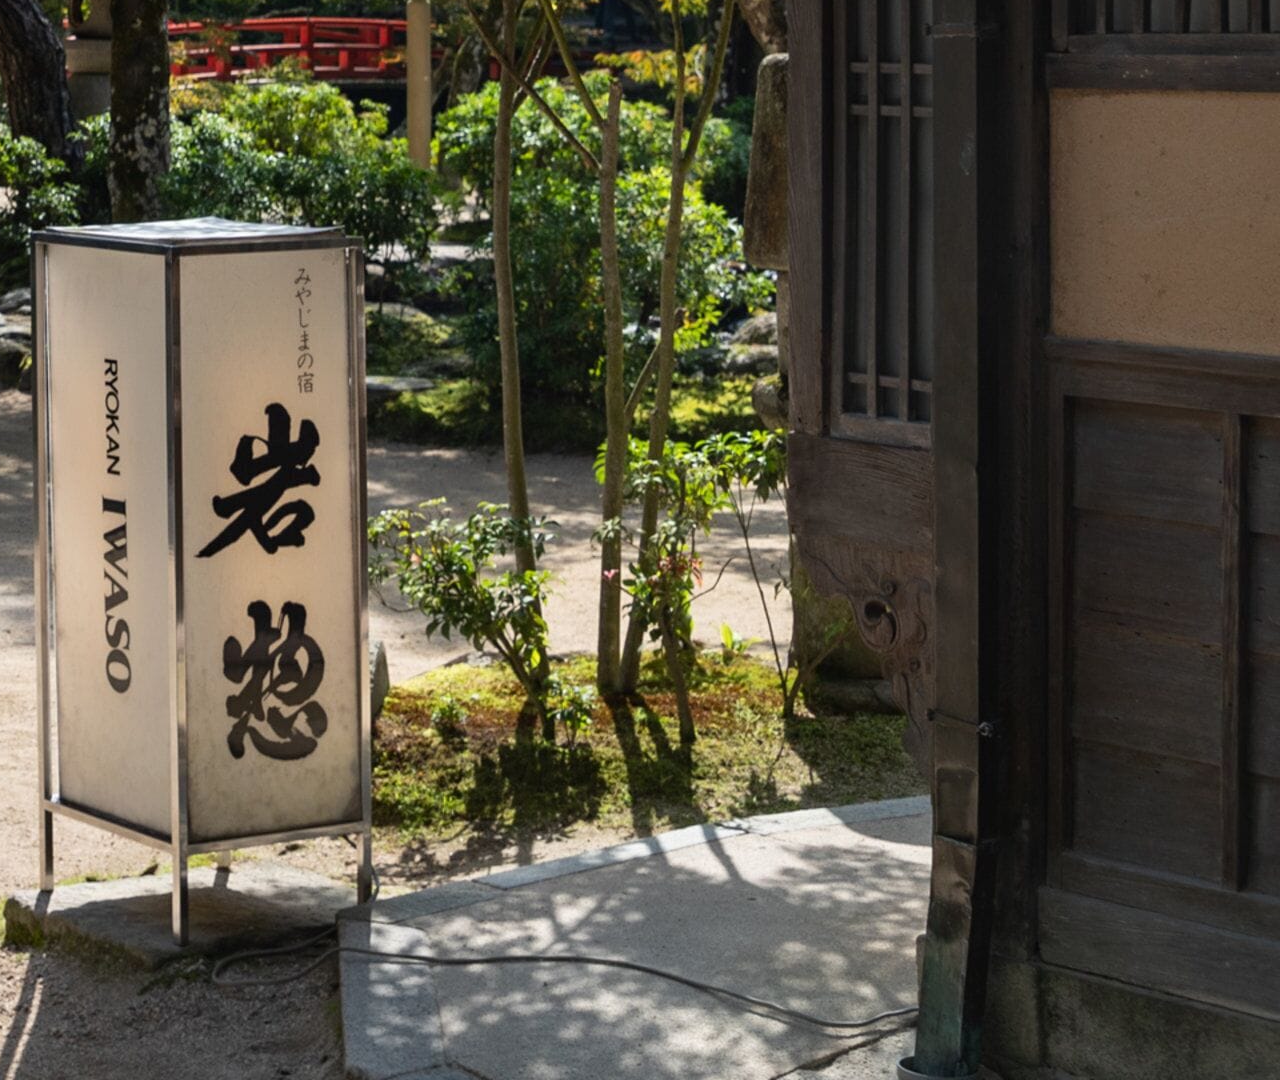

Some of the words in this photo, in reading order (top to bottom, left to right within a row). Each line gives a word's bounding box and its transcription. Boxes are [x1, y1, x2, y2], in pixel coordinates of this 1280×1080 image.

[294, 267, 315, 395] みやじまの宿
[103, 358, 121, 477] RYOKAN
[102, 495, 132, 695] IWASO
[194, 402, 328, 761] 岩惣
